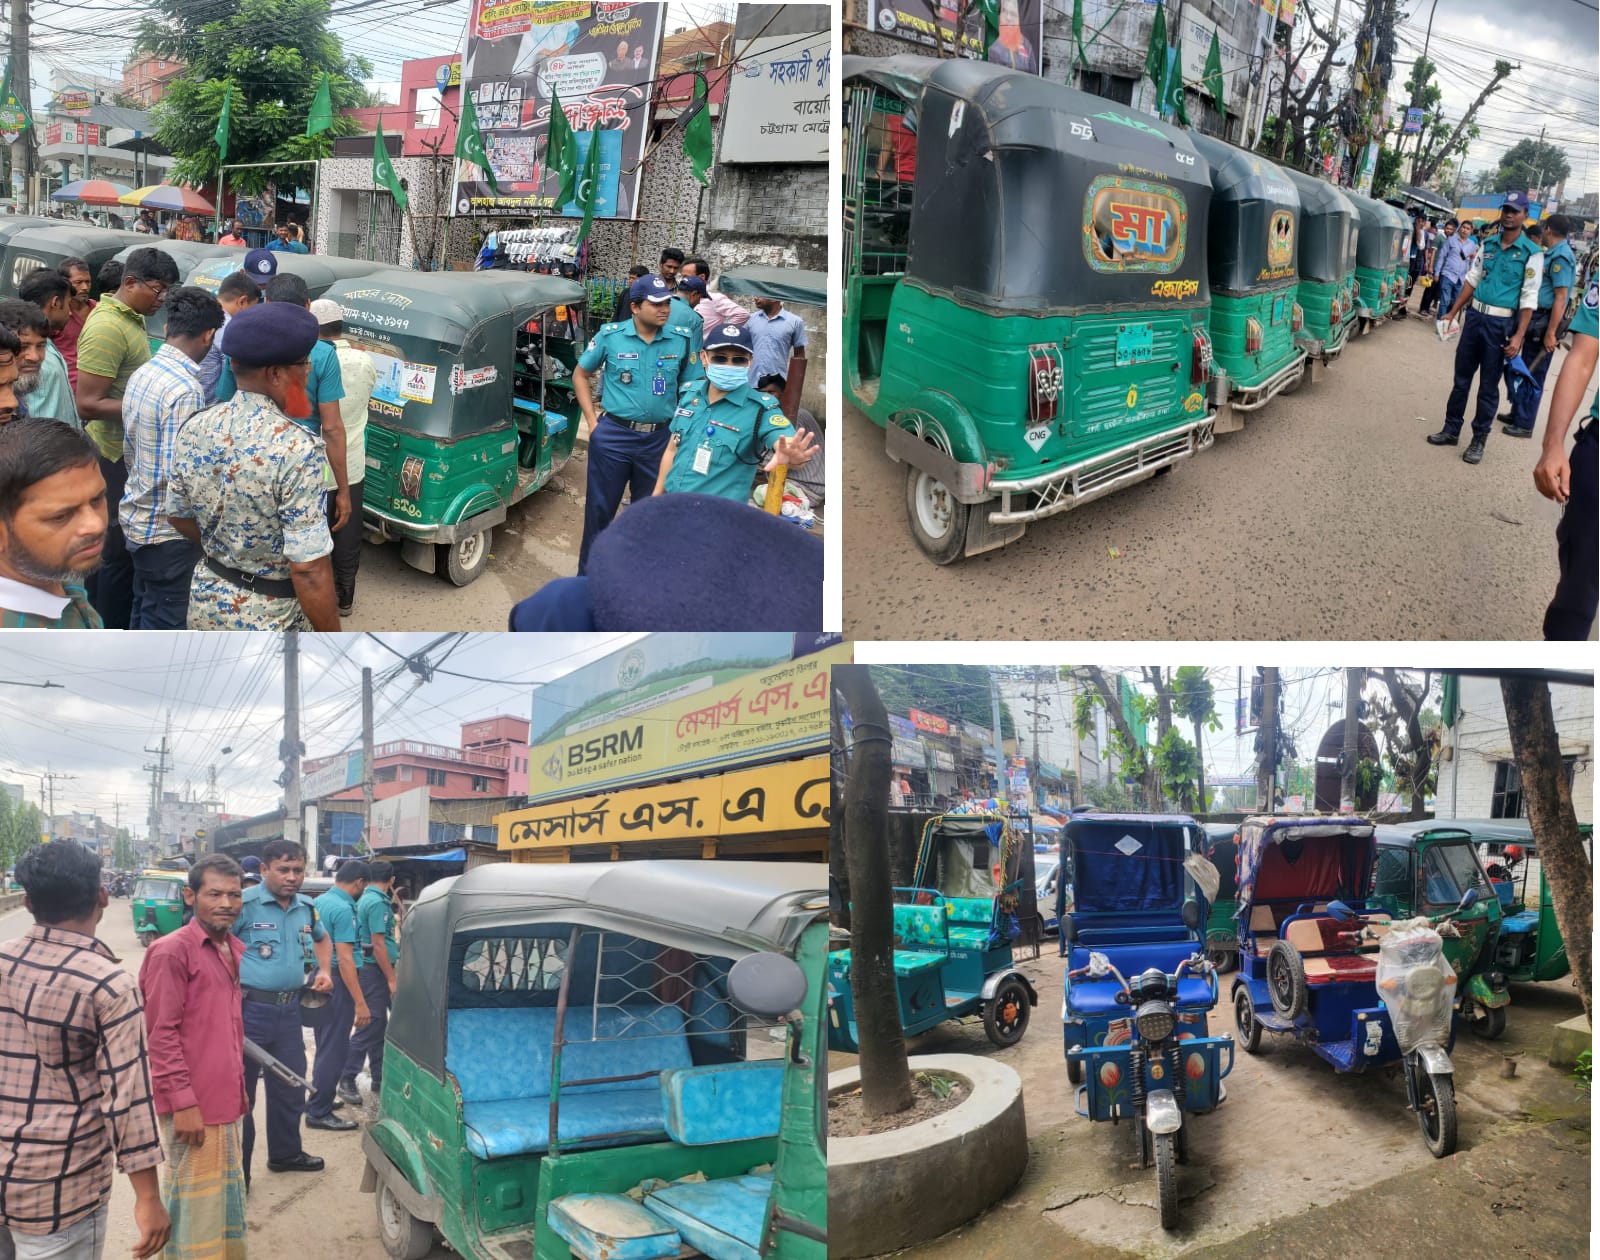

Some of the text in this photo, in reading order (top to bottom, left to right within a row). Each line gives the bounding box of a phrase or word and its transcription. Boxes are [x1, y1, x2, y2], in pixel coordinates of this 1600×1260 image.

[769, 49, 813, 86] সহকারী
[760, 121, 798, 135] চট্টগ্রাম
[1110, 202, 1169, 250] মা
[343, 289, 381, 300] মায়ের
[1029, 430, 1046, 442] CNG
[676, 688, 744, 739] মেসার্স
[749, 682, 799, 716] এস.
[803, 672, 828, 700] এ
[568, 725, 643, 767] BSRM
[567, 765, 592, 777] building
[598, 759, 617, 770] safer
[618, 754, 642, 765] nation
[510, 799, 610, 843] মেসার্স
[620, 797, 704, 832] এস.
[722, 787, 765, 822] এ
